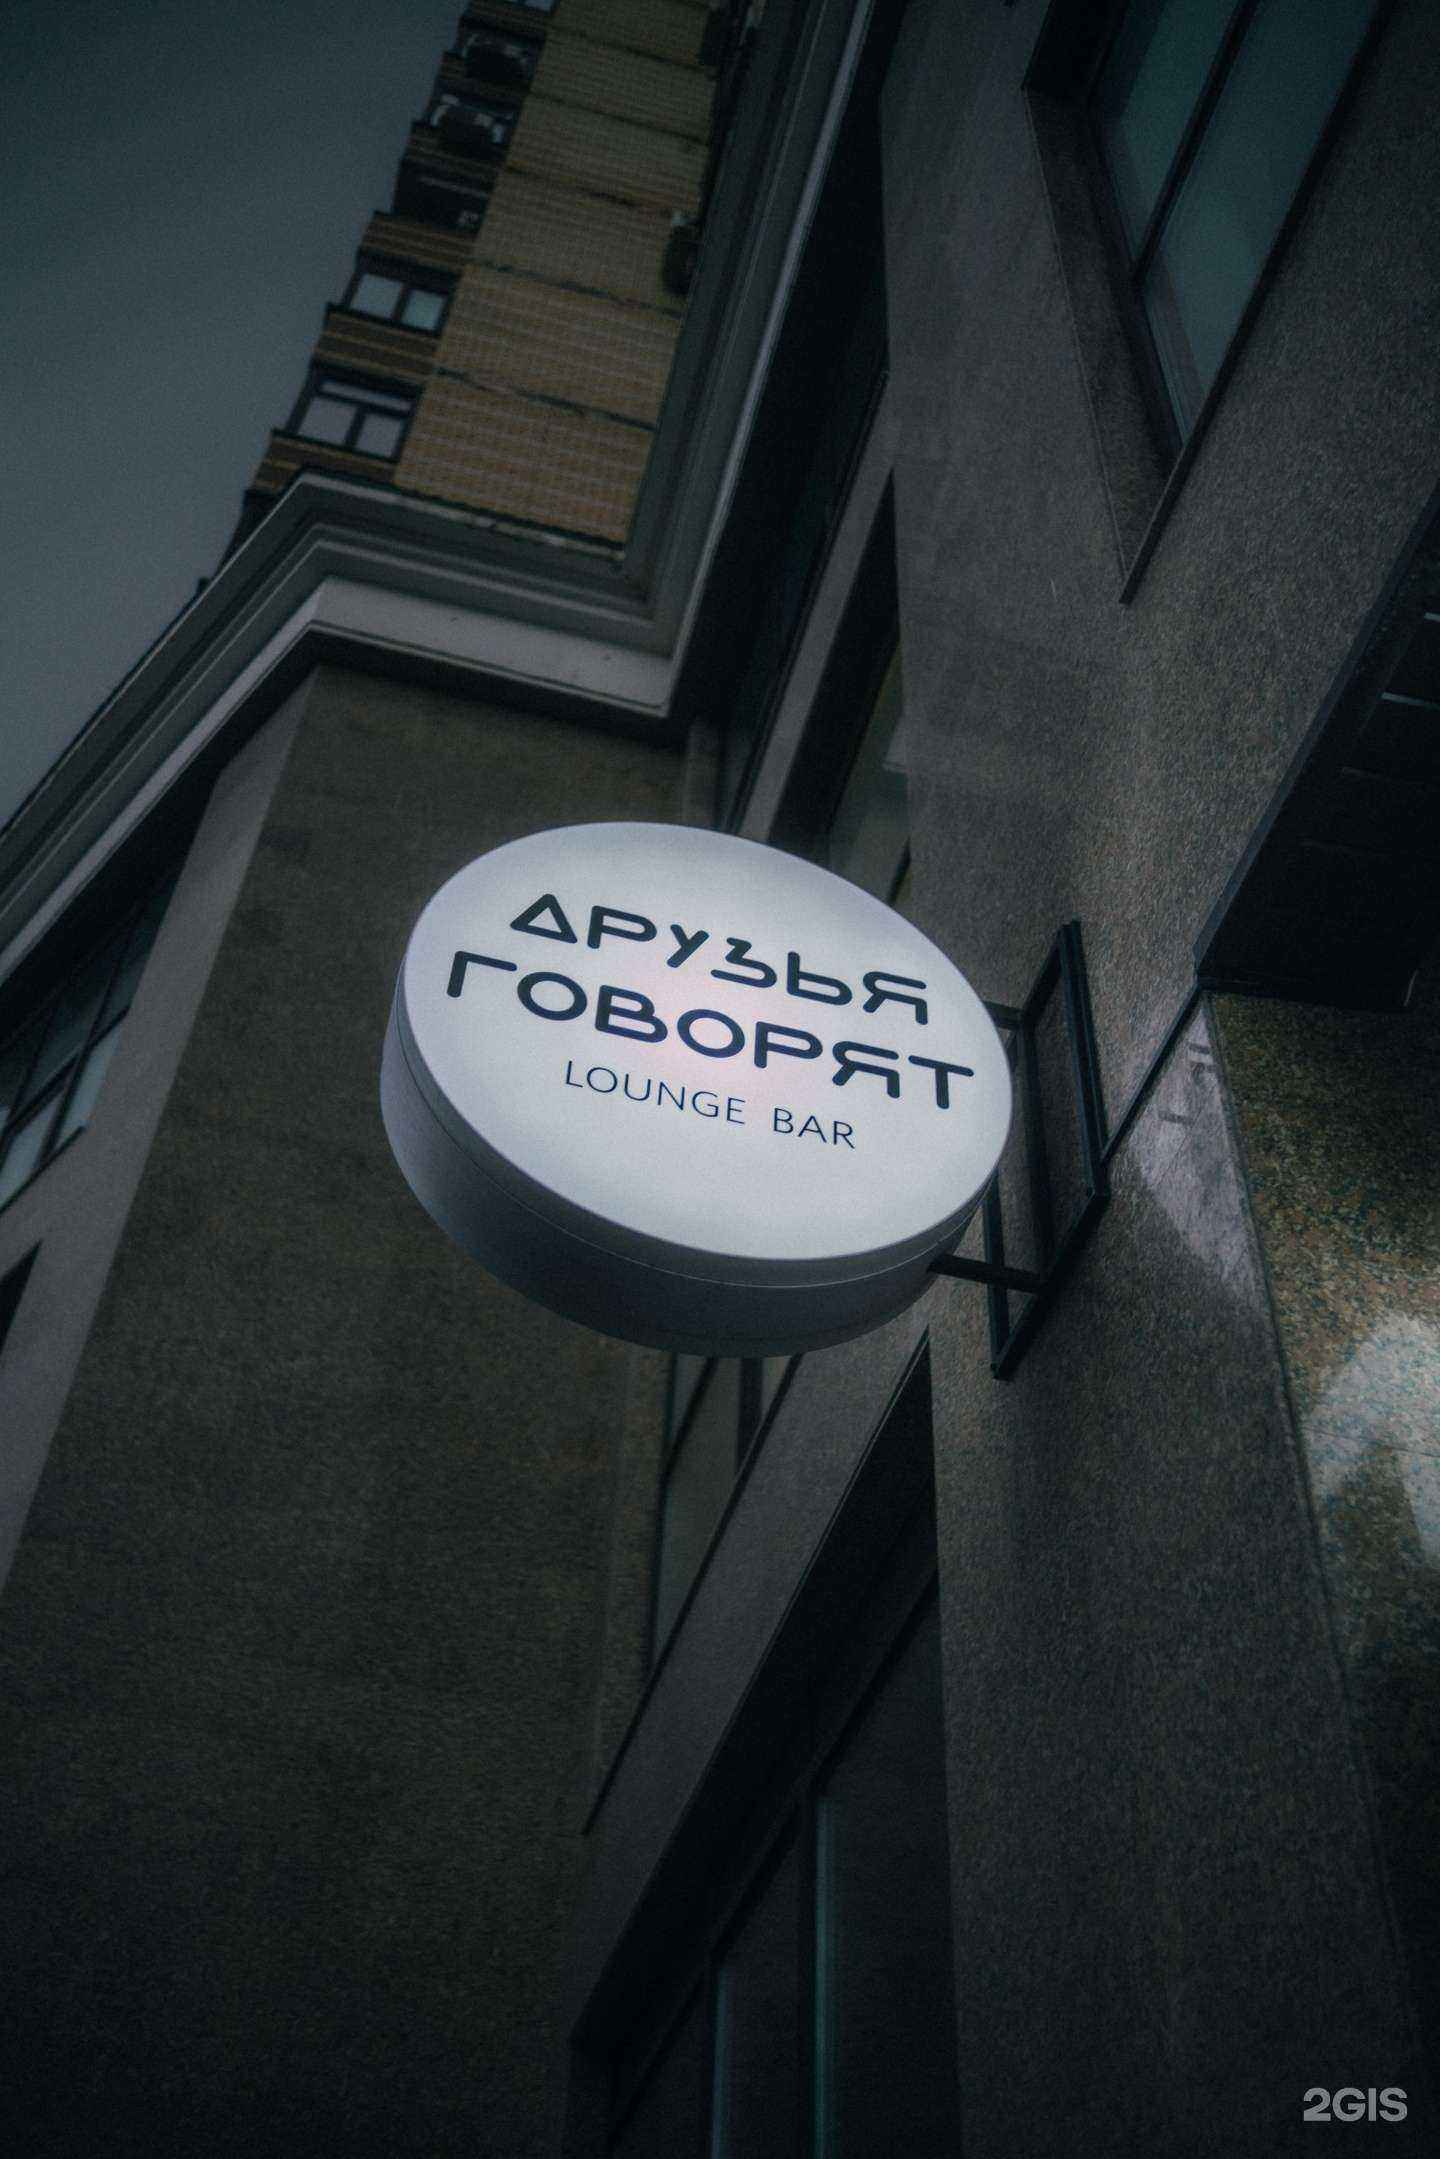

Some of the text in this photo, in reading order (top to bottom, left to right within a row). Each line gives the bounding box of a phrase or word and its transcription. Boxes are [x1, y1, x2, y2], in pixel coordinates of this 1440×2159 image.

[509, 893, 929, 1026] ДРУЗЬЯ
[446, 950, 975, 1110] ГОВОРЯТ
[564, 1060, 856, 1150] LOUNGE BAR
